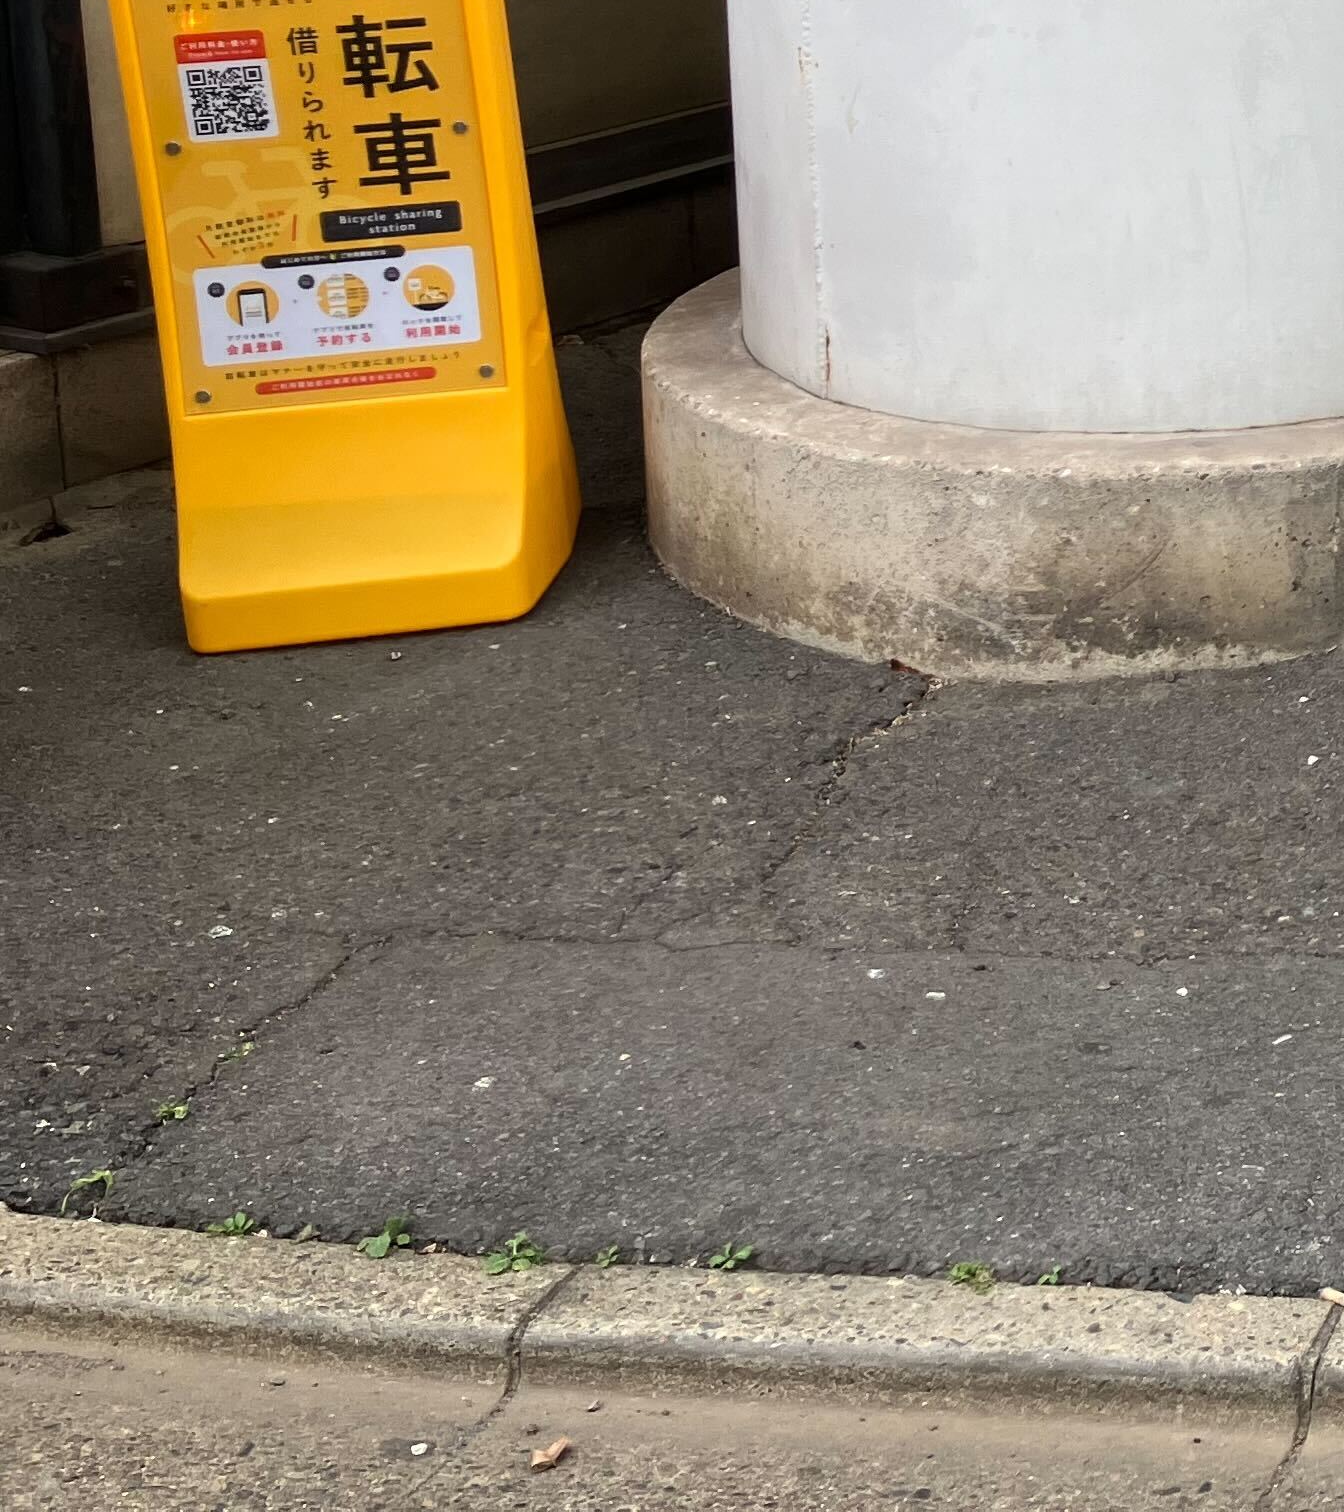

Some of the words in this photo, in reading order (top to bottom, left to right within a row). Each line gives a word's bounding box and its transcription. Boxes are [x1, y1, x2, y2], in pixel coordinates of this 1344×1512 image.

[286, 27, 338, 199] 借りられます
[338, 210, 387, 226] Bicycle
[394, 207, 443, 221] sharing
[368, 222, 417, 235] station
[316, 332, 373, 347] 予約する
